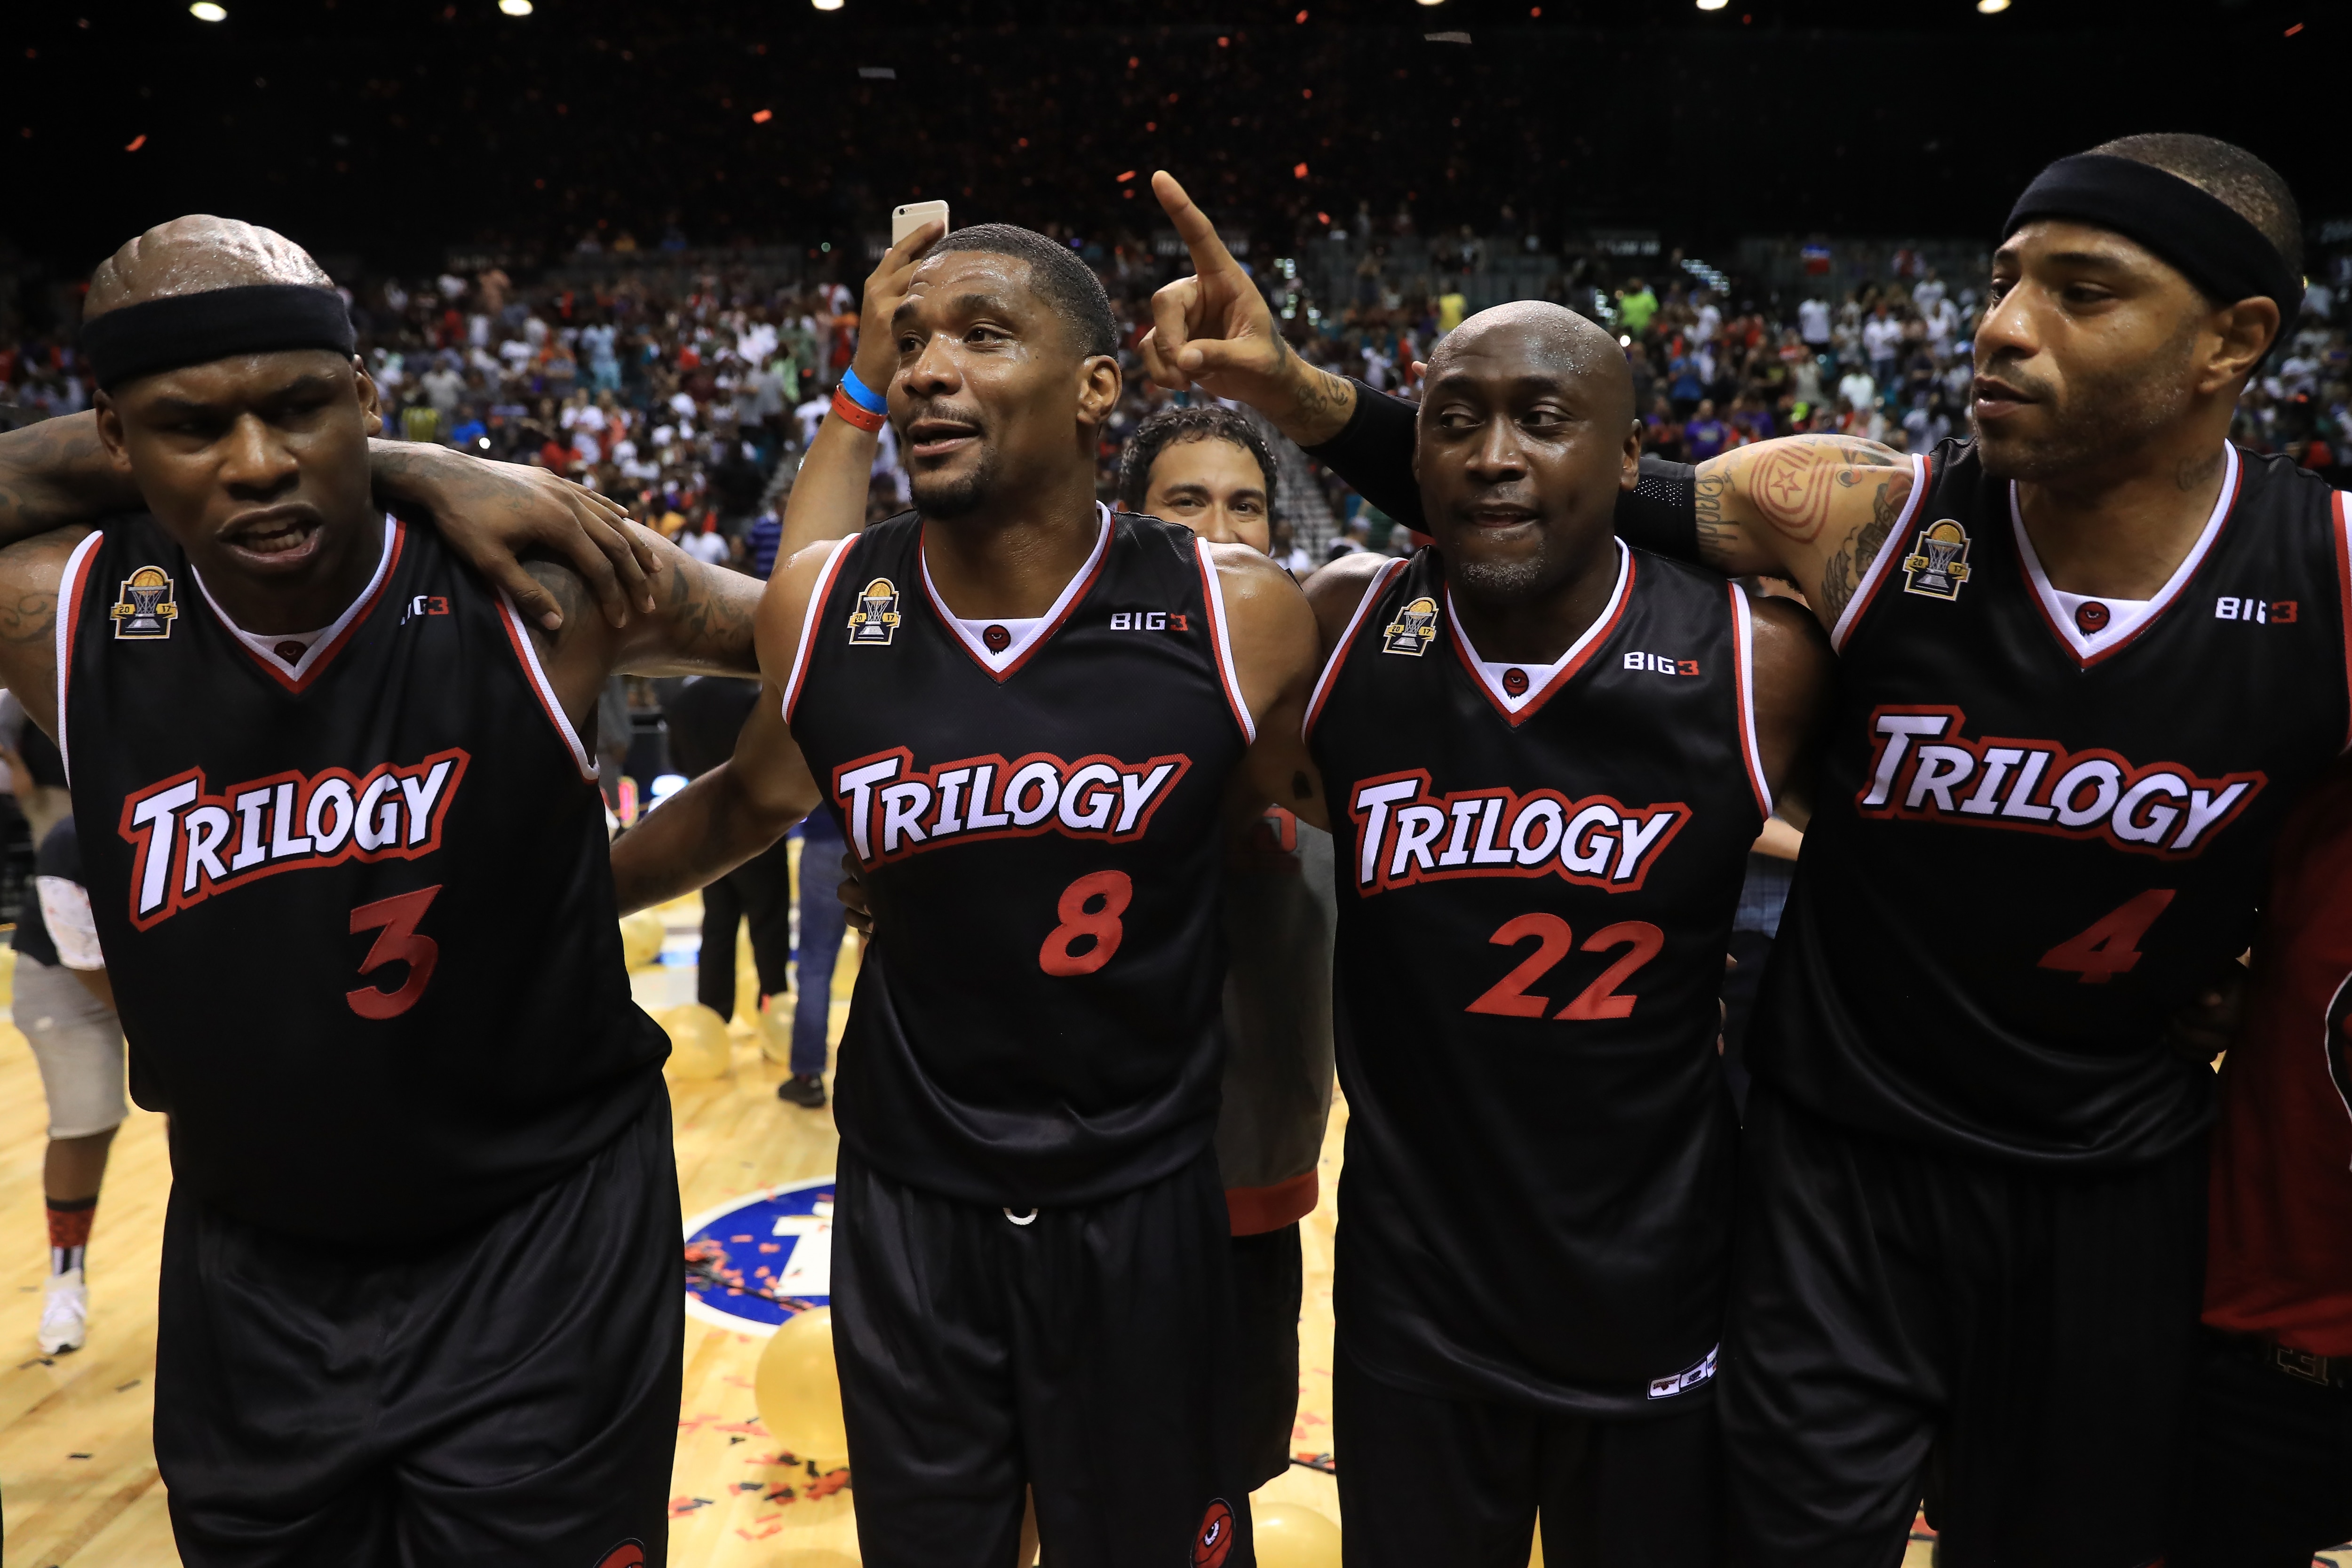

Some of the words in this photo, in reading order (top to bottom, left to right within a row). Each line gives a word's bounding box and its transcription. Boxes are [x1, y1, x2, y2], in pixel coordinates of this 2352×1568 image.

[400, 595, 450, 625] IG3
[1110, 612, 1189, 631] BIG3
[1623, 651, 1700, 676] BIG3
[836, 752, 1183, 866] TRILOGY
[1353, 774, 1683, 890] TRILOGY
[1859, 710, 2258, 854] TRILOGY
[126, 754, 461, 922] TRILOGY
[346, 884, 443, 1020] 3
[1039, 870, 1133, 977] 8
[1464, 912, 1664, 1020] 22
[2037, 888, 2177, 983] 4
